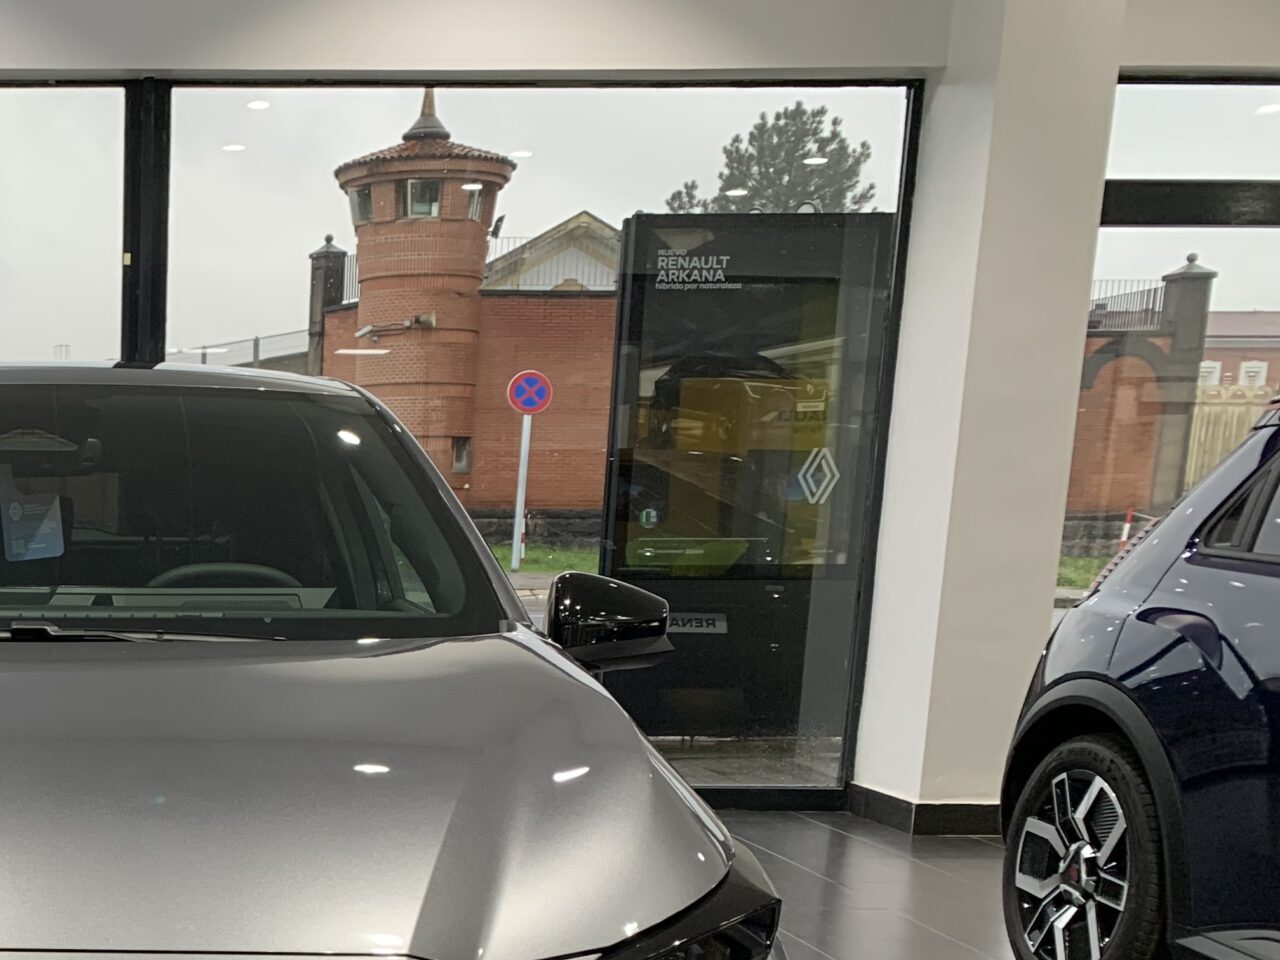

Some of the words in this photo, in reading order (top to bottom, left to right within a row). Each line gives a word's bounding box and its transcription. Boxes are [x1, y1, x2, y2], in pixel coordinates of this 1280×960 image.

[657, 256, 730, 269] RENAULT
[656, 269, 726, 282] ARKANA
[684, 282, 698, 291] por
[699, 281, 743, 290] naturaleza
